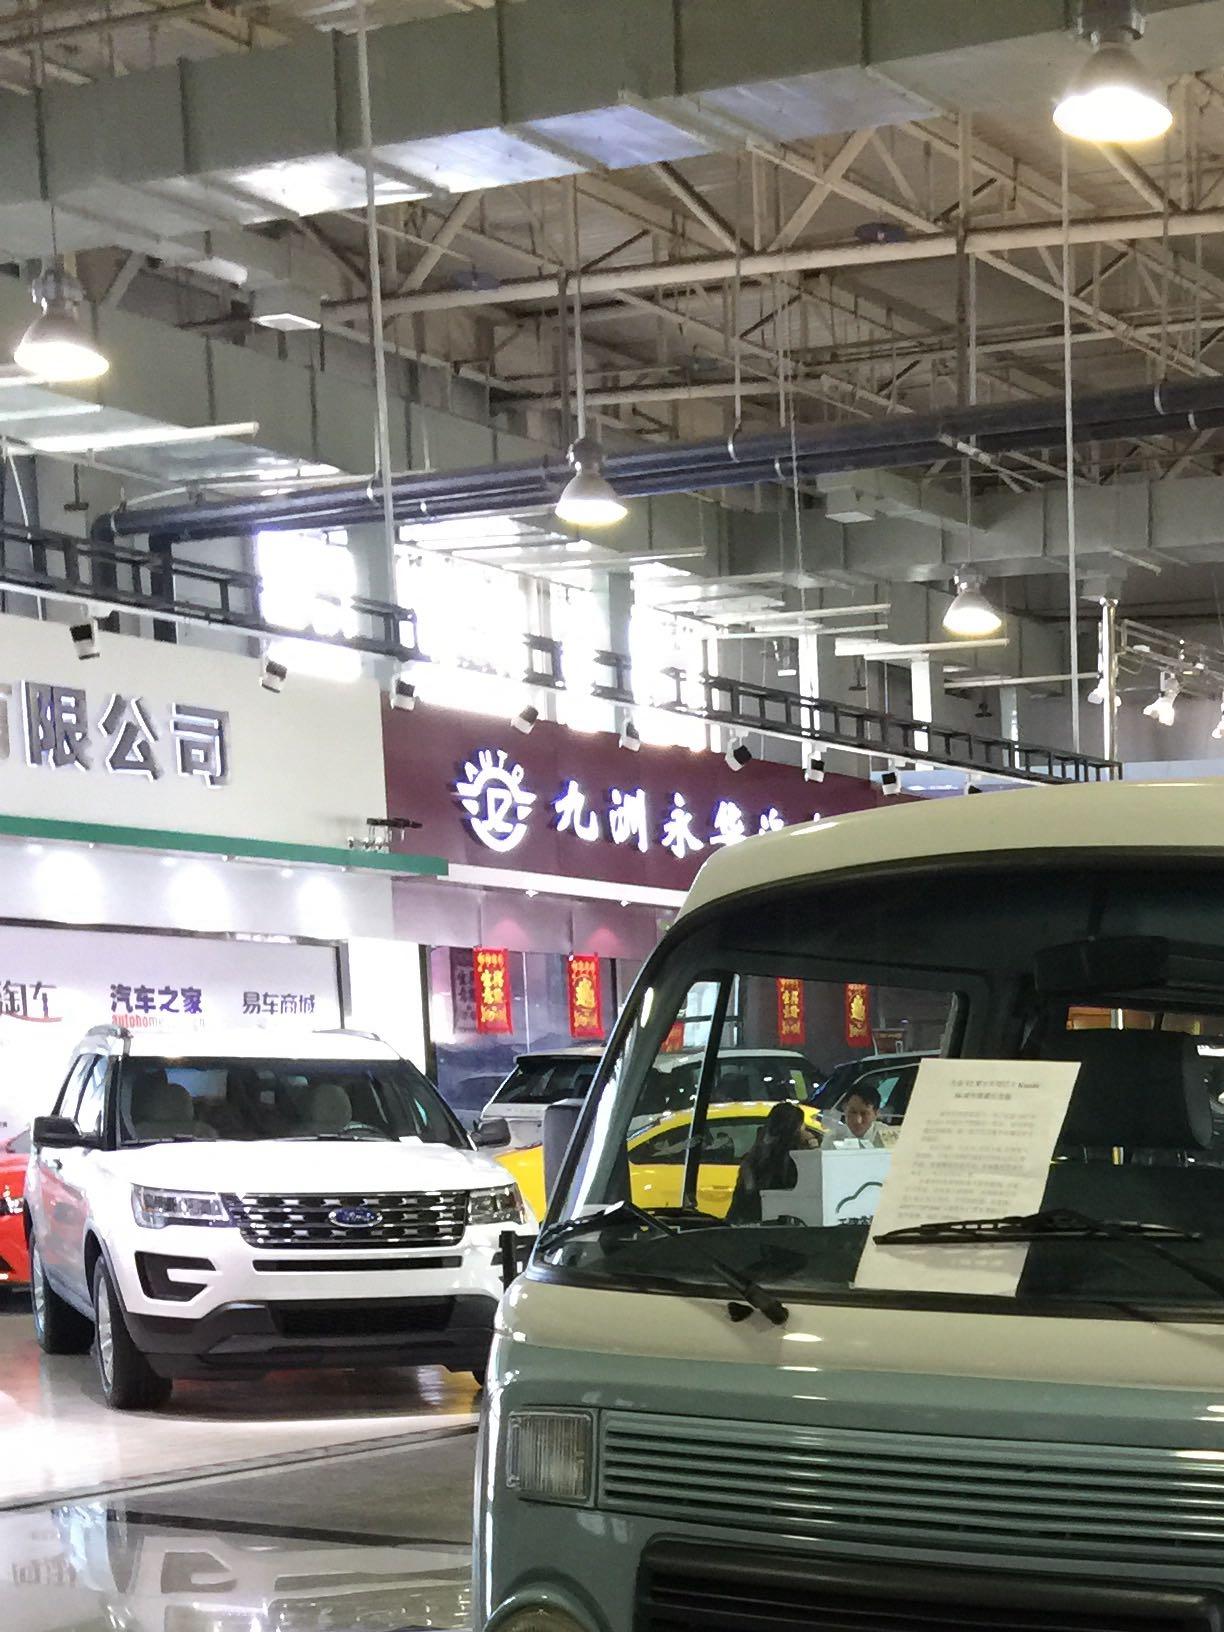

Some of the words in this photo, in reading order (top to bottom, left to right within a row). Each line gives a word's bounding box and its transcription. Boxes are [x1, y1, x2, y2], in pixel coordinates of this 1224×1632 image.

[0, 679, 229, 789] 限公司
[109, 983, 203, 1015] 汽车之家
[242, 990, 316, 1016] 易车商城
